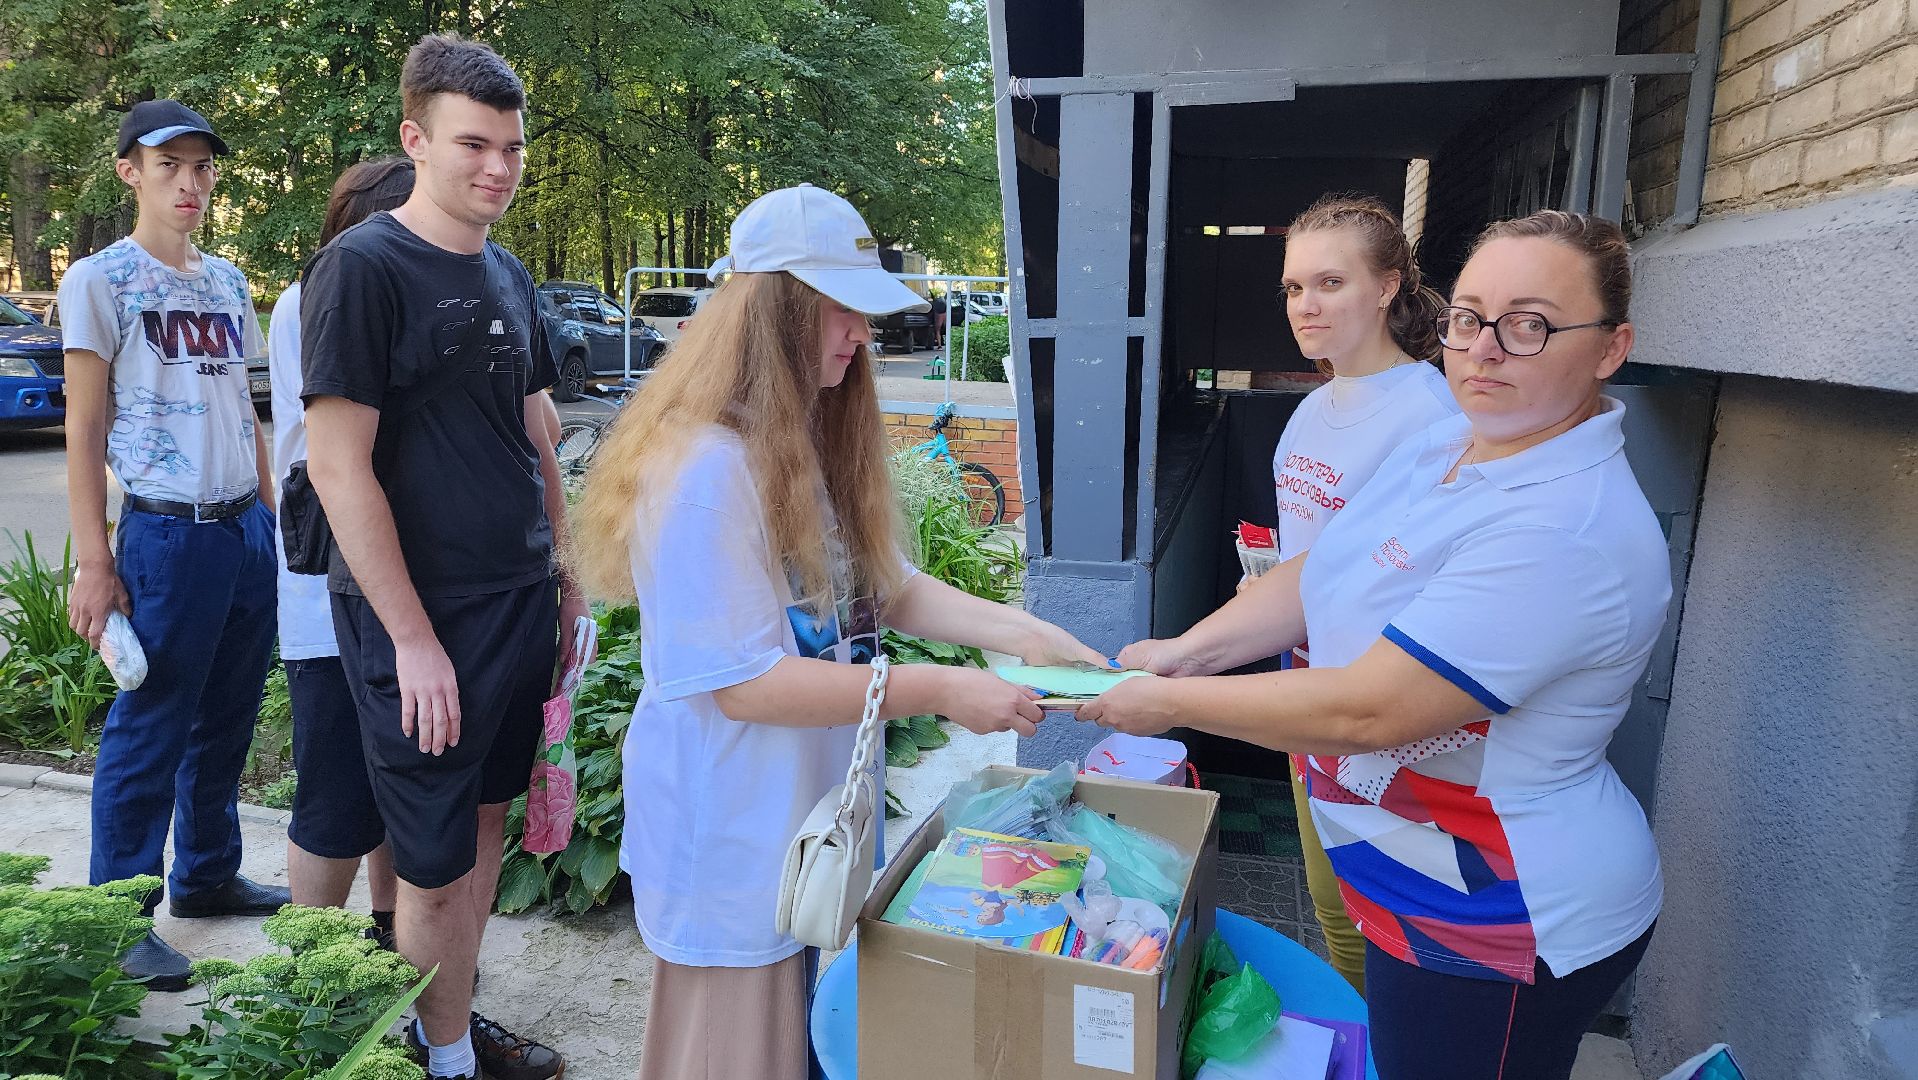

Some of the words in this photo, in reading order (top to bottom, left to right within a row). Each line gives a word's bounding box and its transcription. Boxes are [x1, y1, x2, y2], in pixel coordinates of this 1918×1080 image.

[196, 363, 228, 376] JEANS
[1283, 451, 1344, 487] ОЛОНТЕРЫ
[1276, 474, 1346, 511] ДМОСКОВЬЯ
